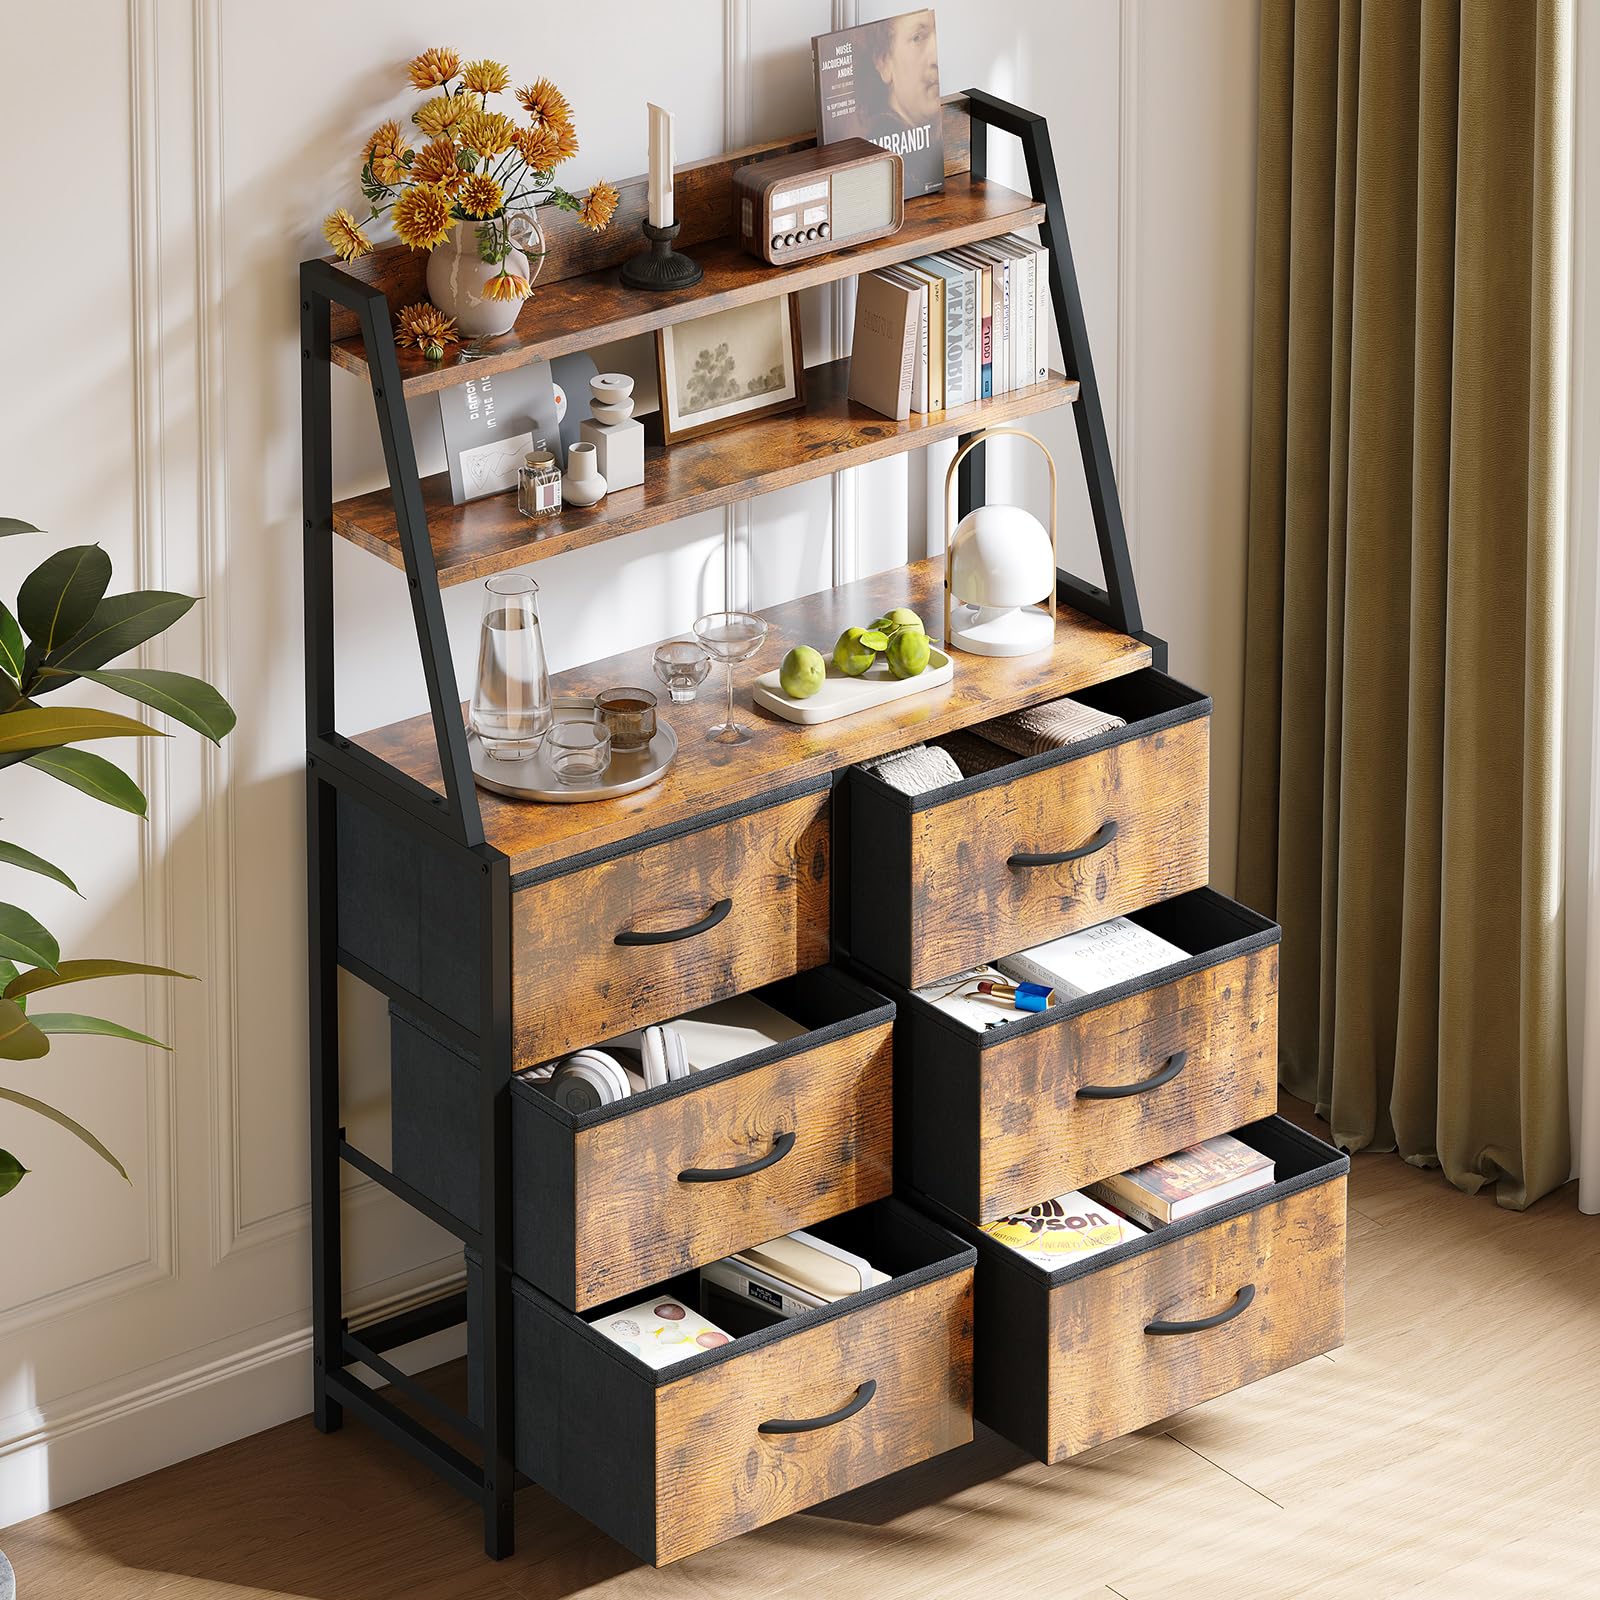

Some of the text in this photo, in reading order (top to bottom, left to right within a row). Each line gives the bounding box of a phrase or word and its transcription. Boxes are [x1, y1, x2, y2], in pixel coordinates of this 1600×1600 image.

[836, 42, 852, 56] MUSÉE
[822, 55, 853, 71] JACQUEMART
[838, 66, 854, 79] ANDRÉ
[868, 124, 932, 155] MBRANDT
[466, 380, 480, 420] DIAMON
[484, 397, 495, 416] THE
[486, 418, 497, 429] IN
[1016, 1199, 1064, 1217] ill
[996, 1213, 1110, 1234] ryson
[992, 1232, 1022, 1244] HISTORY
